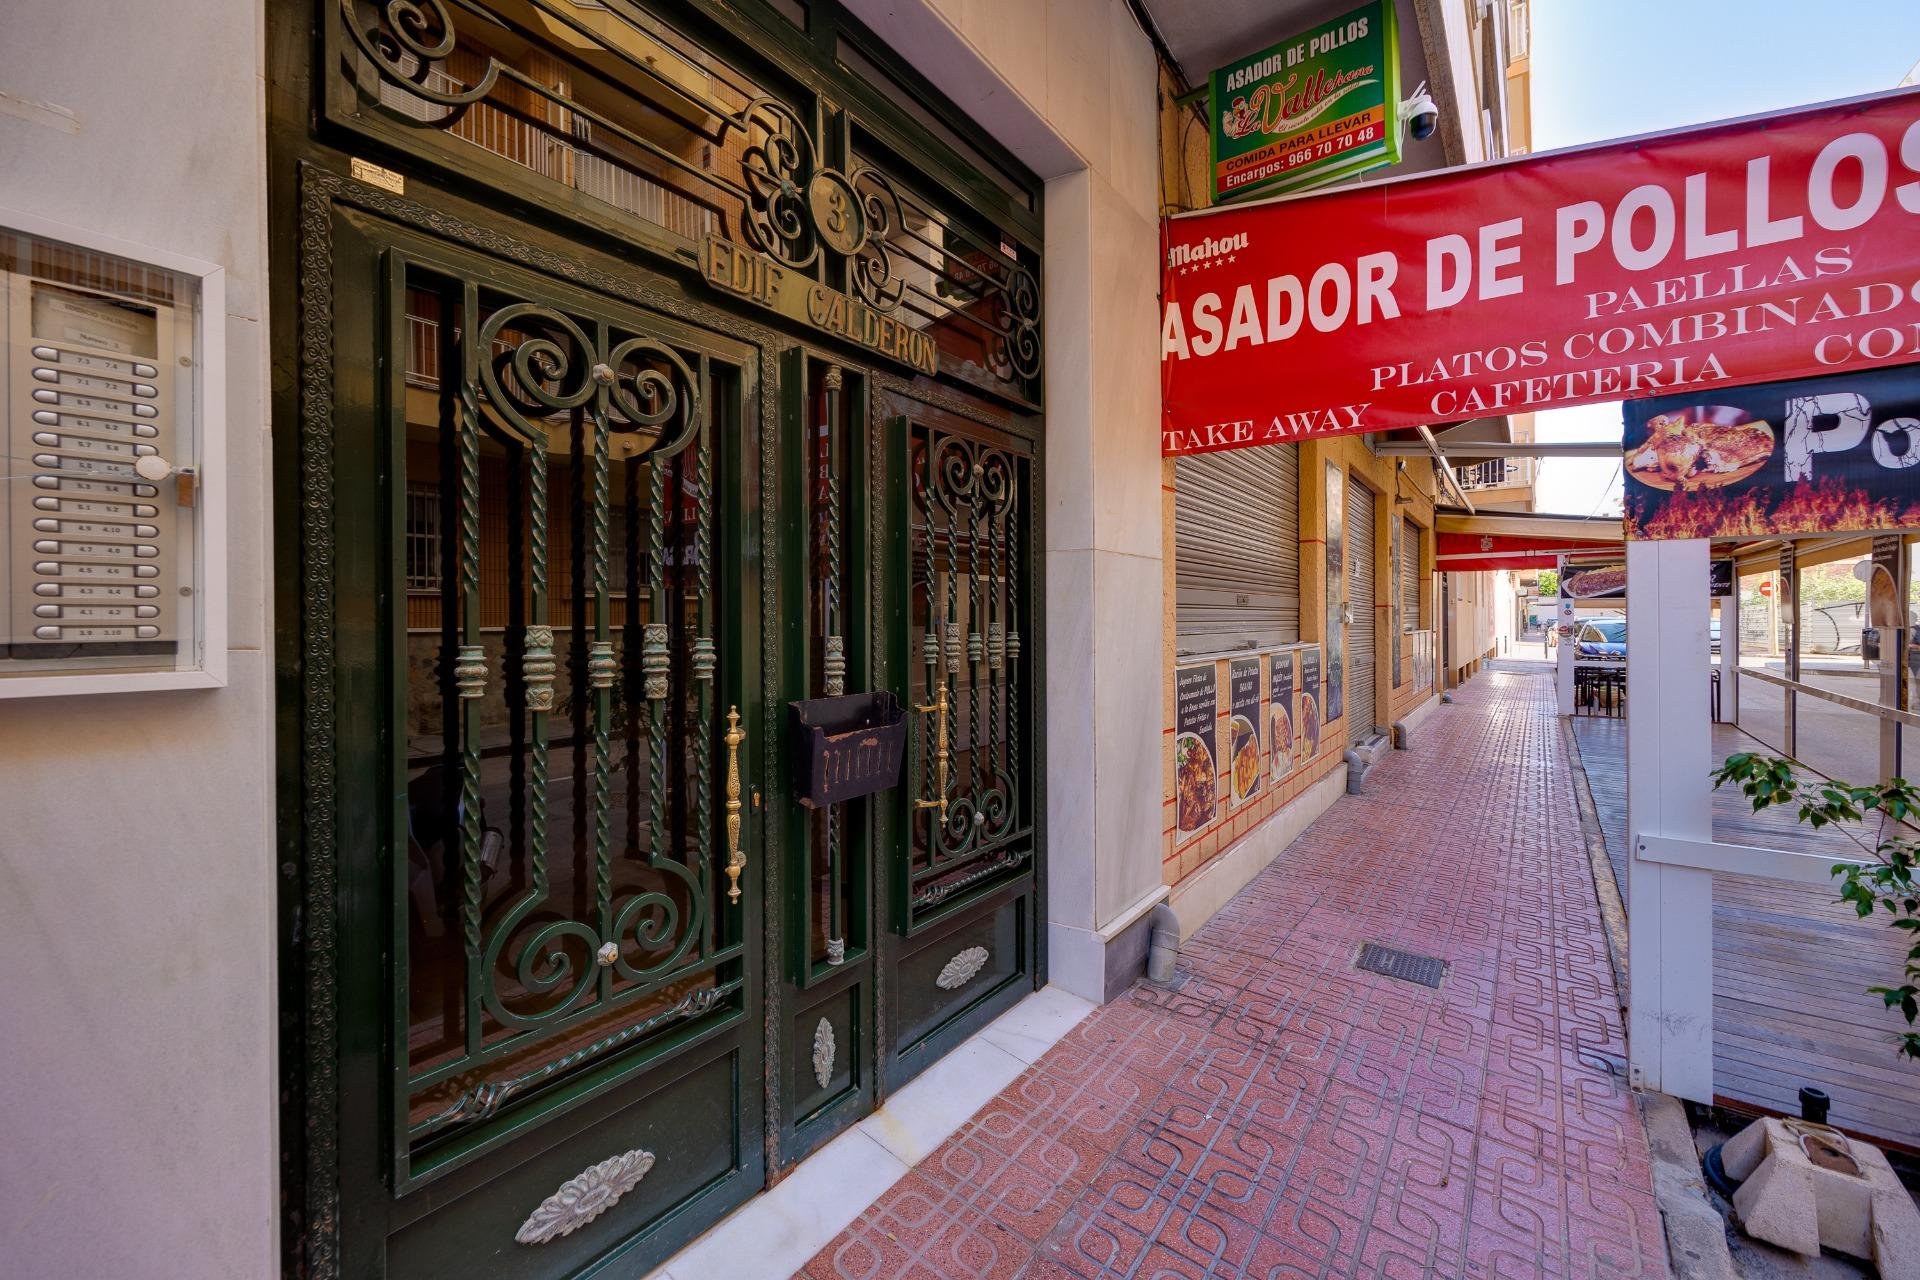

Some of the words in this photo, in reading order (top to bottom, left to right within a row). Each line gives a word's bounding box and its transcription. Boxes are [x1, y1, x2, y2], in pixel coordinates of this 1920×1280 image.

[1226, 54, 1282, 92] ASADOR
[1287, 43, 1305, 68] DE
[1309, 16, 1369, 58] POLLOS
[1226, 149, 1276, 171] COMIDA
[1279, 131, 1315, 156] PARA
[1318, 111, 1371, 141] LLEVAR
[1226, 160, 1284, 188] Encargos:
[1288, 147, 1312, 167] 966
[1316, 142, 1332, 159] 70
[1336, 133, 1353, 149] 70
[1357, 126, 1374, 141] 48
[826, 192, 846, 233] 3
[1169, 232, 1250, 268] Mahou
[1583, 245, 1854, 320] PAELLAS
[707, 238, 783, 306] EDIF
[807, 283, 936, 372] CALDERON
[1161, 251, 1401, 361] ASADOR
[1426, 217, 1524, 311] DE
[1370, 340, 1548, 391] PLATOS
[1563, 279, 1920, 360] COMBINAD
[1430, 353, 1732, 416] CAFETERIA
[1162, 421, 1253, 451] TAKE
[1263, 403, 1372, 439] AWAY
[1784, 393, 1920, 482] Po
